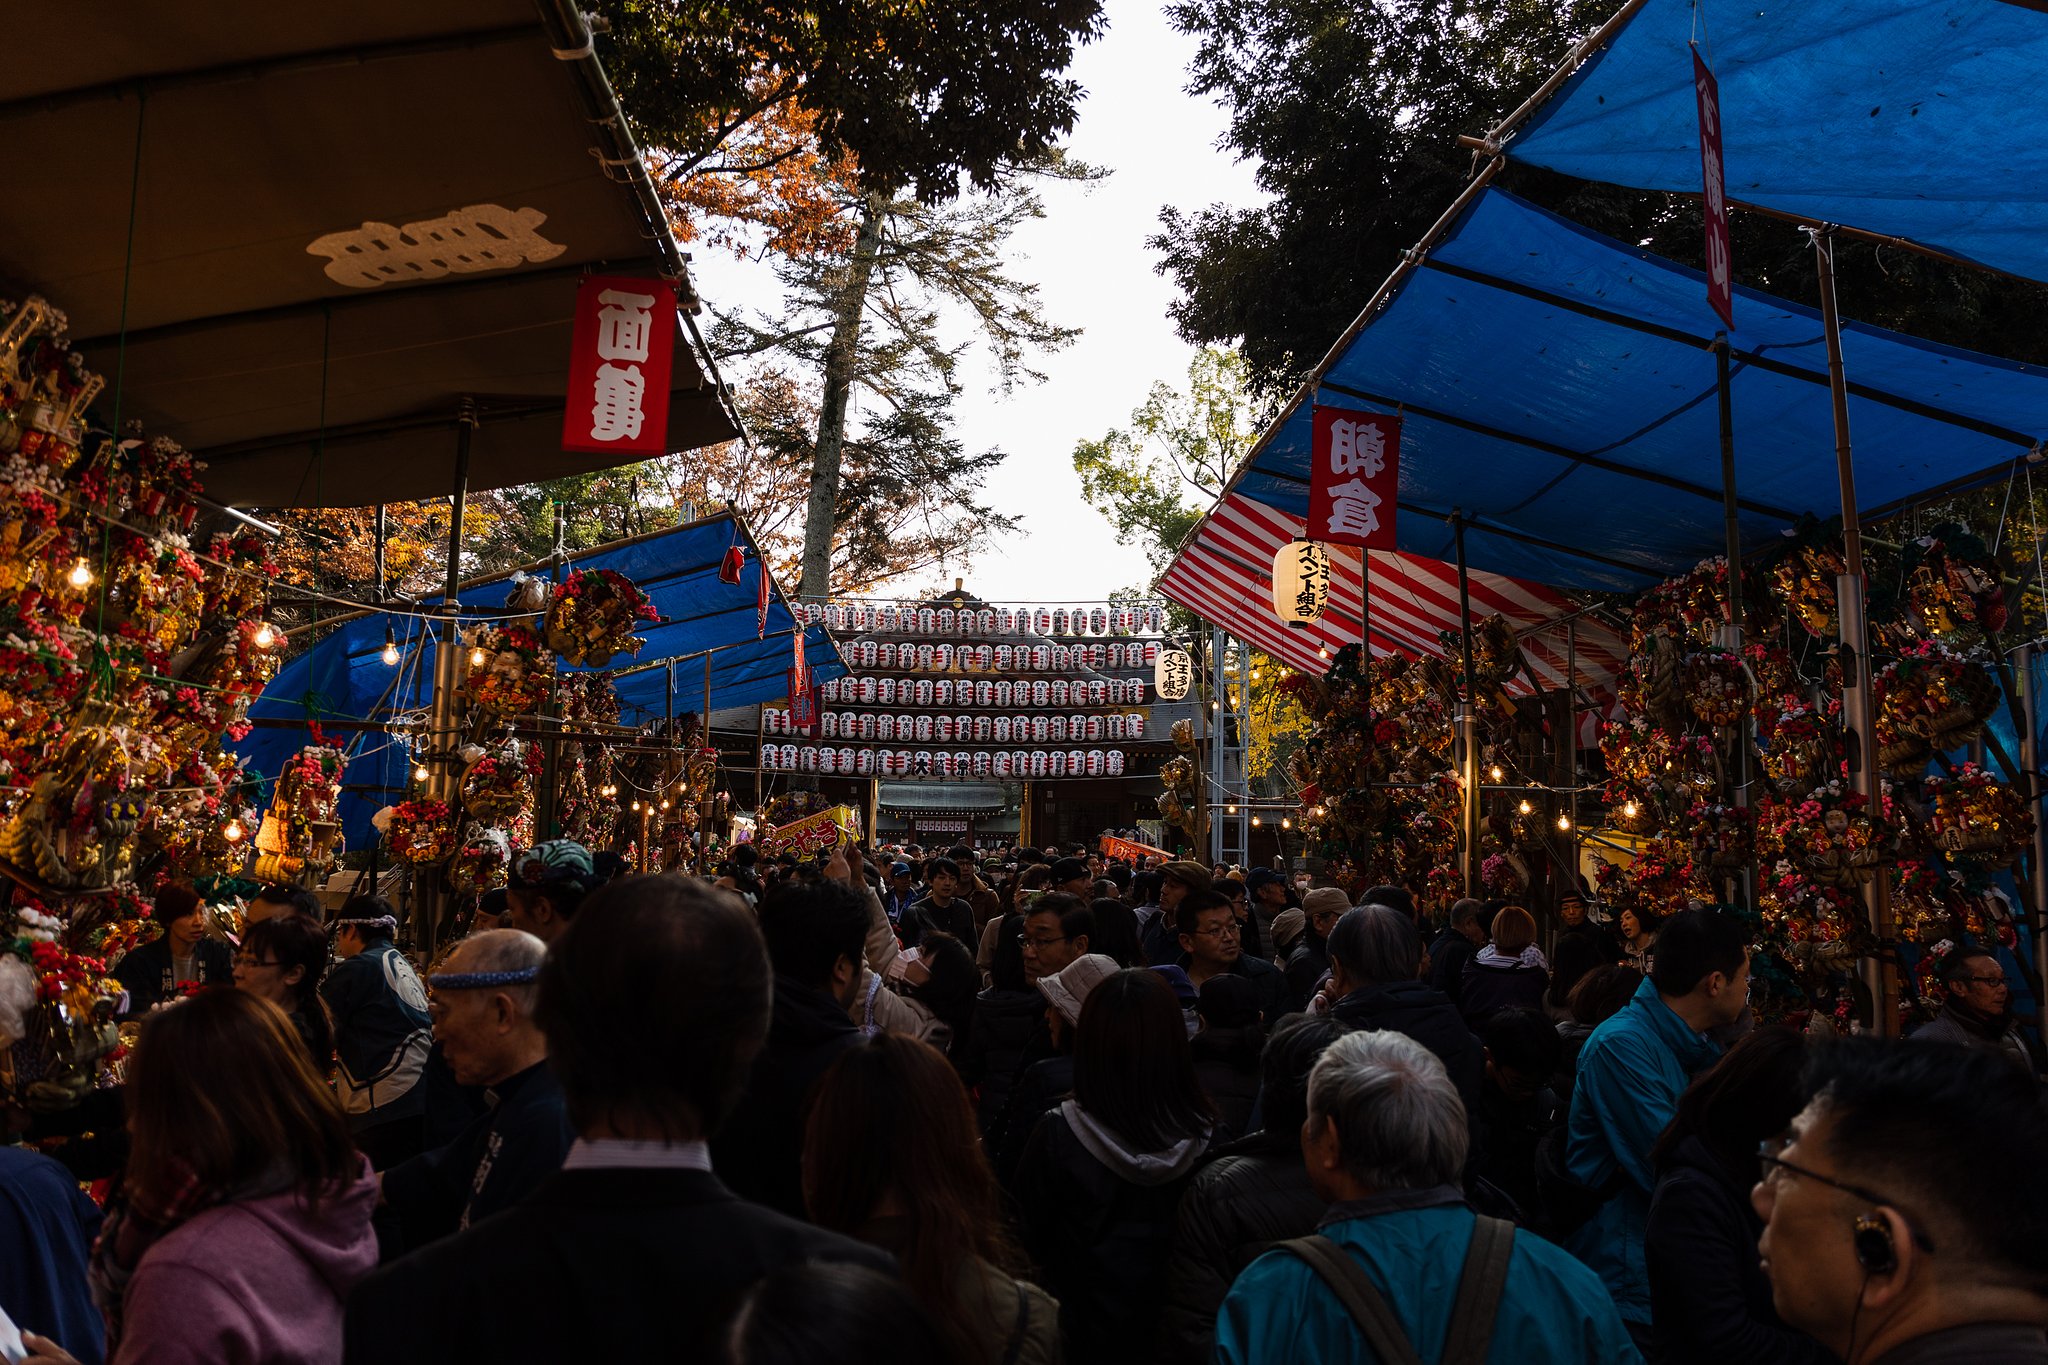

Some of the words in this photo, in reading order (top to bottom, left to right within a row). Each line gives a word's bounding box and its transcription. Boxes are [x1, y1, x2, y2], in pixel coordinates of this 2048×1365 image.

[1295, 545, 1319, 617] イベント組合
[1163, 652, 1177, 698] イベント組合
[914, 758, 928, 775] 大
[780, 819, 838, 858] こやき
